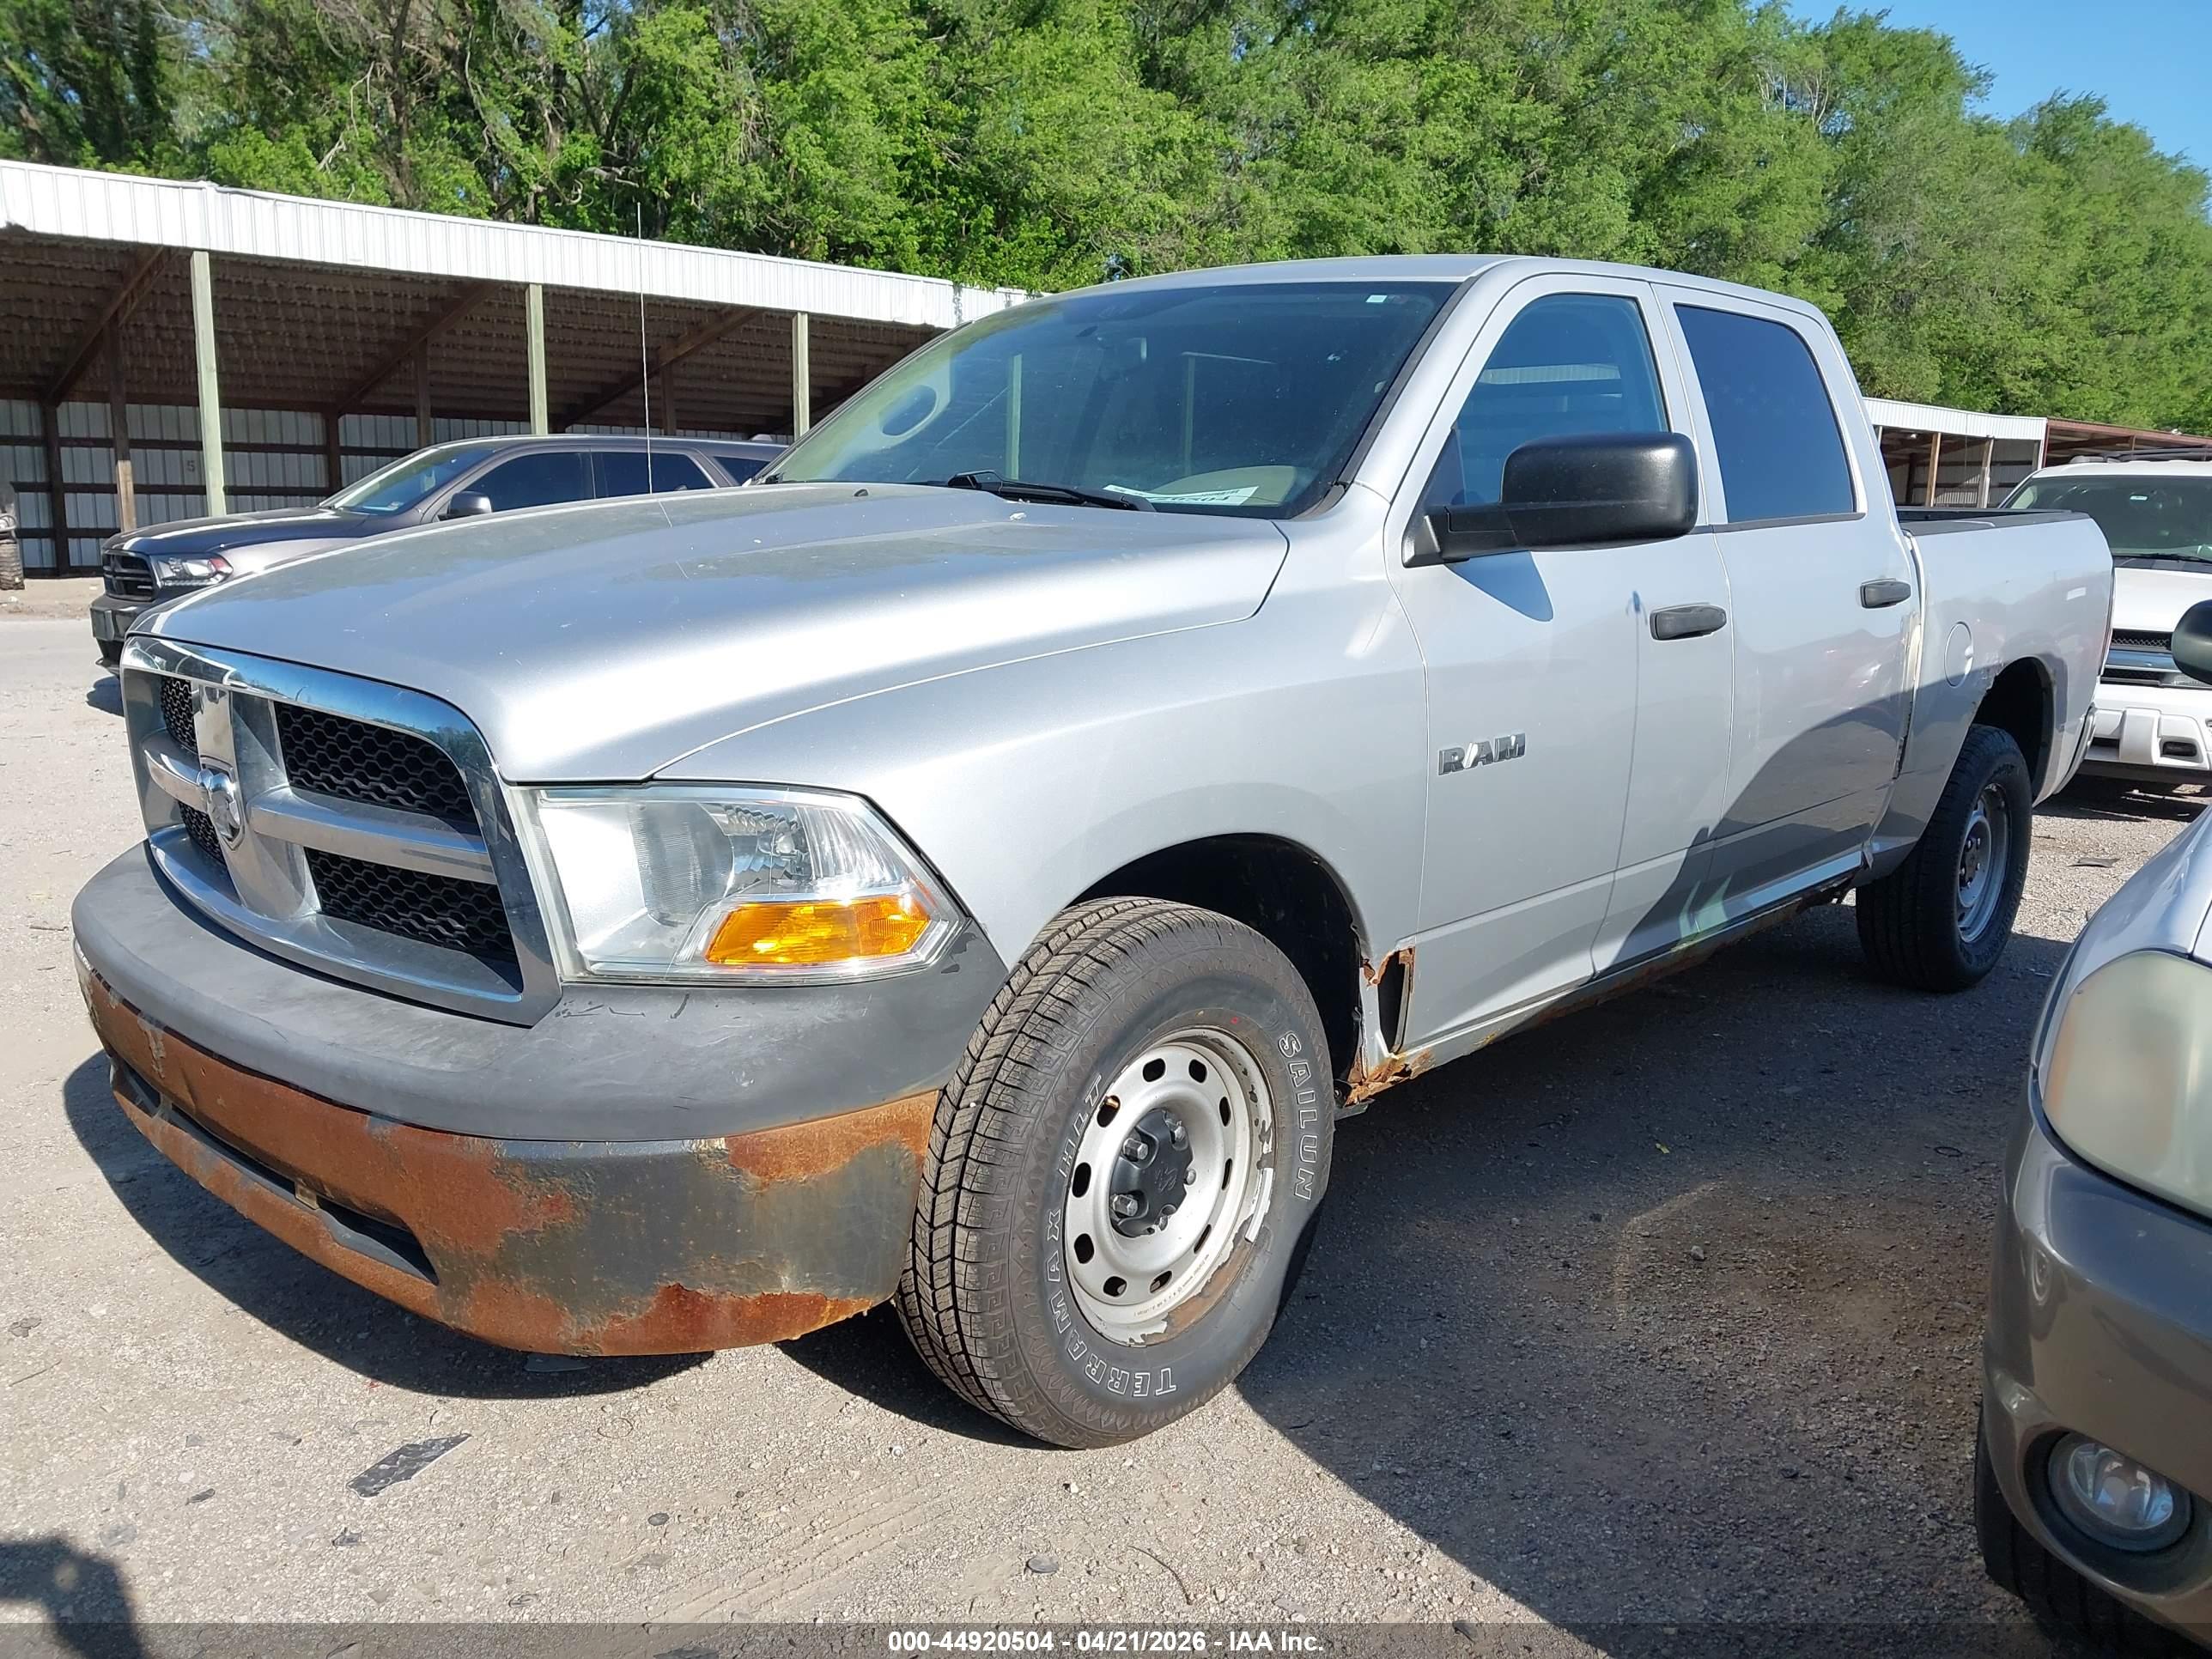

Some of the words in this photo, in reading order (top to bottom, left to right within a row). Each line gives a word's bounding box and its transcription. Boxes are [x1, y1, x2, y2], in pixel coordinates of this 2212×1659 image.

[1437, 732, 1526, 775] RAM
[1278, 1032, 1318, 1200] SAILUN
[1047, 1208, 1176, 1397] TERRAMAX
